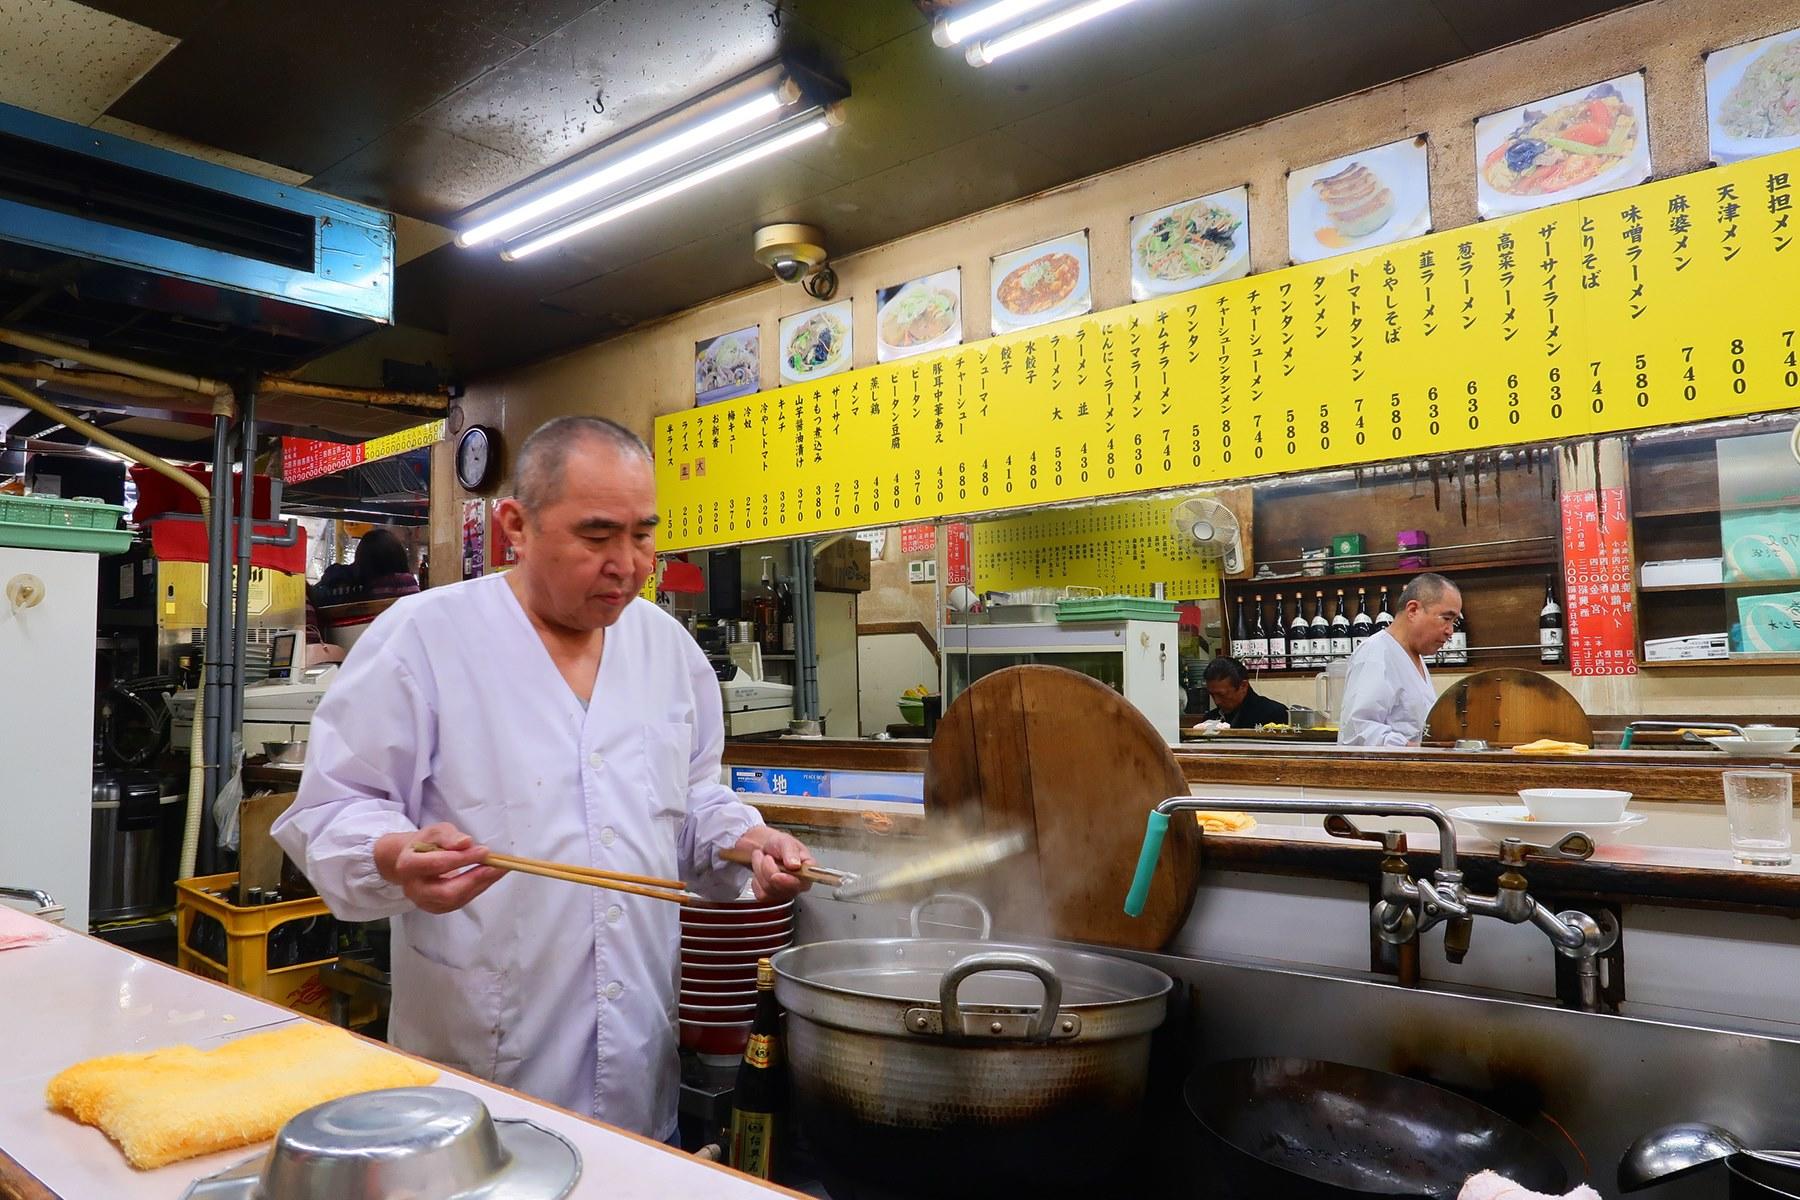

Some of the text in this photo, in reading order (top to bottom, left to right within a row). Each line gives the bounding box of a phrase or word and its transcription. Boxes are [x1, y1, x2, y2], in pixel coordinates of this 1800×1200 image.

[1348, 269, 1366, 446] トマトタンメン 740
[1384, 260, 1402, 441] もやしそば 580
[1457, 242, 1479, 431] 葱ラーメン 630
[1497, 233, 1520, 425] 高菜ラーメン 630
[1539, 222, 1563, 419] ザーサイラーメン 630
[1581, 217, 1604, 414] とりそば 740
[1621, 205, 1649, 408] 味噌ラーメン 580
[1668, 195, 1697, 401] 麻婆メン 740
[1717, 184, 1747, 395] 天津メン 800
[1766, 173, 1799, 388] 担担メン 740
[851, 383, 859, 416] メンマ
[870, 377, 881, 415] 蒸し鶏
[890, 372, 901, 451] ピータン豆腐
[911, 367, 921, 420] ピータン
[956, 358, 966, 434] チャーシュー
[979, 353, 989, 416] シューマイ
[1001, 347, 1013, 493] 餃子 410
[1026, 342, 1038, 490] 水餃子 480
[1050, 336, 1063, 487] ラーメン 大 530
[1077, 330, 1089, 483] ラーメン 並 430
[1103, 325, 1115, 479] にんにくラーメン 480
[1131, 319, 1143, 476] メンマラーメン 630
[1158, 313, 1172, 472] キムチラーメン 740
[1187, 305, 1201, 468] ワンタン 530
[1217, 297, 1232, 464] チャーシューワンタンメン 800
[1248, 290, 1264, 459] チャーシューメン 740
[1280, 284, 1296, 455] ワンタンメン 580
[1314, 277, 1330, 450] タンメン 580
[1427, 387, 1440, 436] 630
[936, 467, 944, 503] 430
[772, 774, 787, 794] 地
